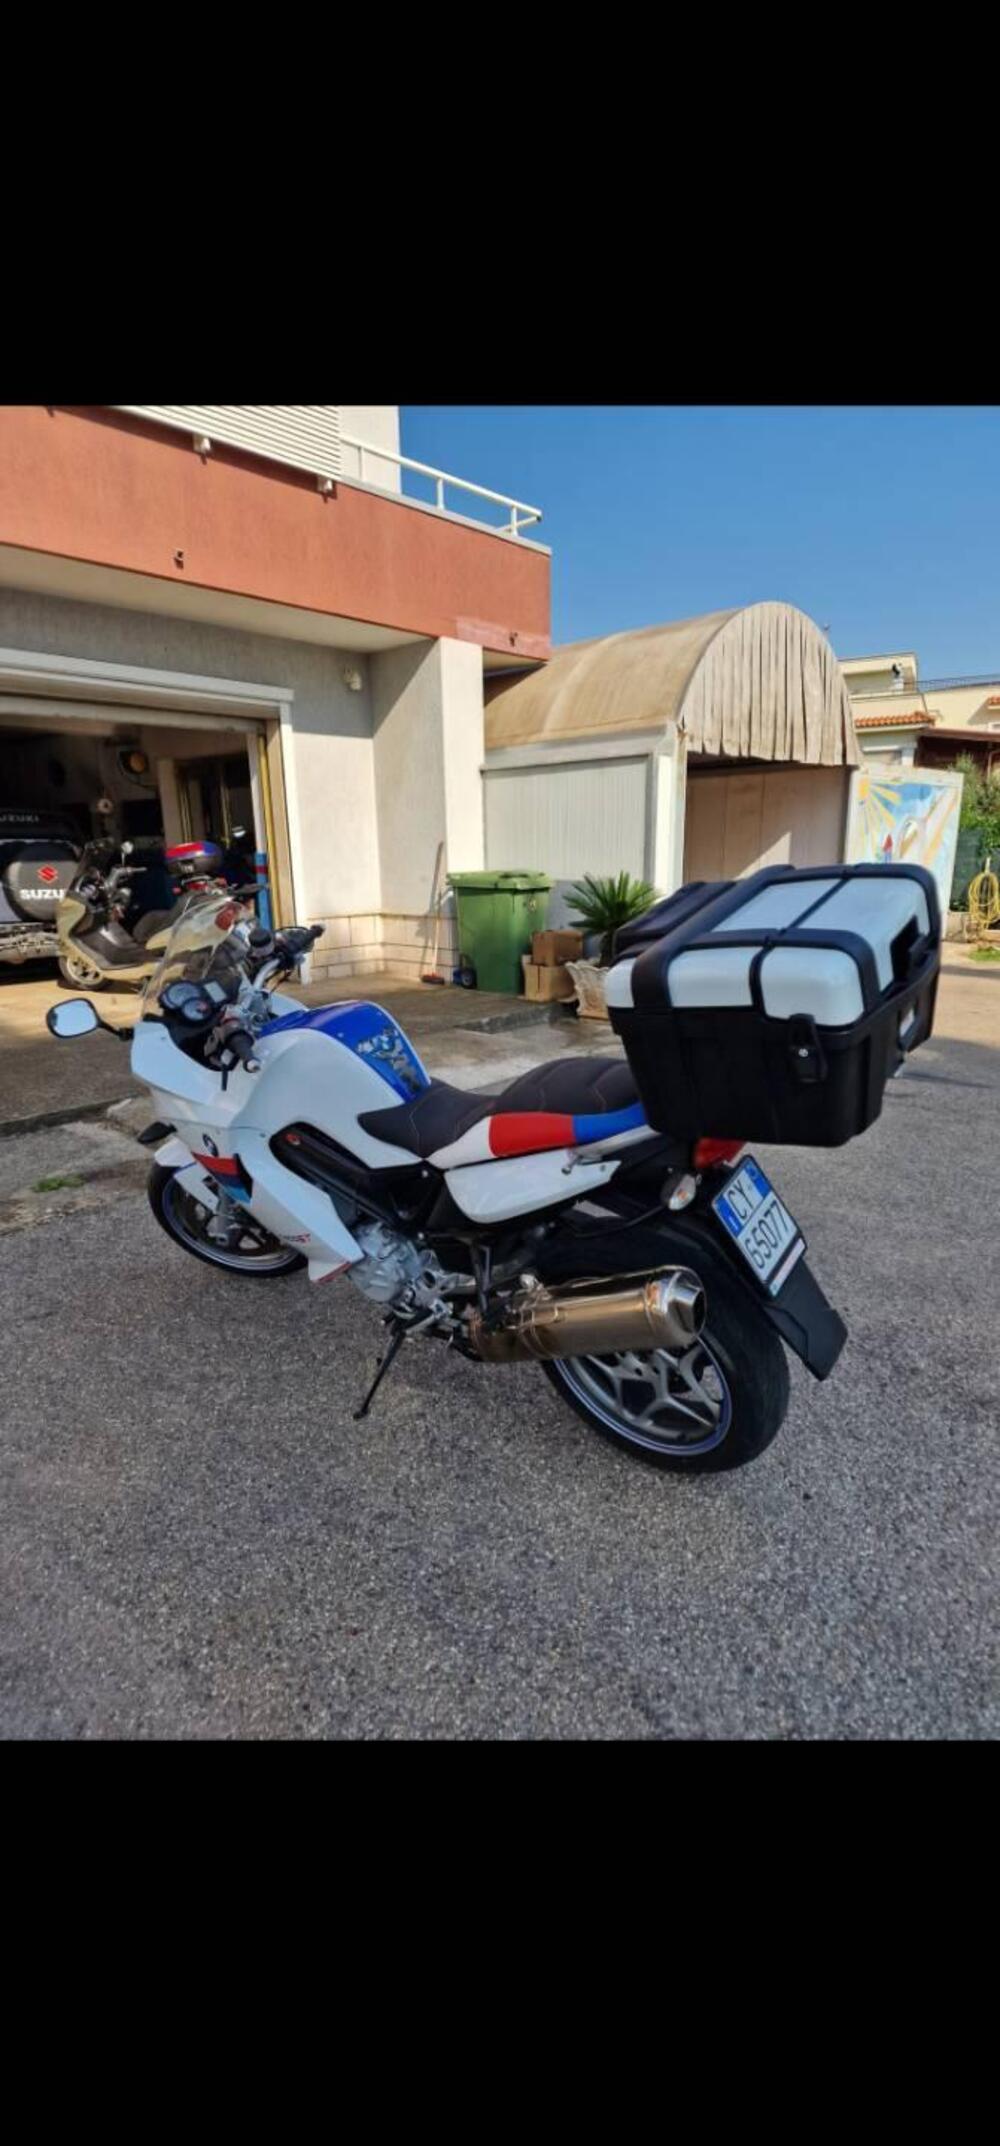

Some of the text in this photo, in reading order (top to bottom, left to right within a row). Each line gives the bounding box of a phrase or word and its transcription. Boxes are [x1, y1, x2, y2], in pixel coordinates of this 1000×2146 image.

[20, 888, 65, 901] SUZU
[727, 1179, 754, 1220] CY
[744, 1200, 789, 1269] 65077
